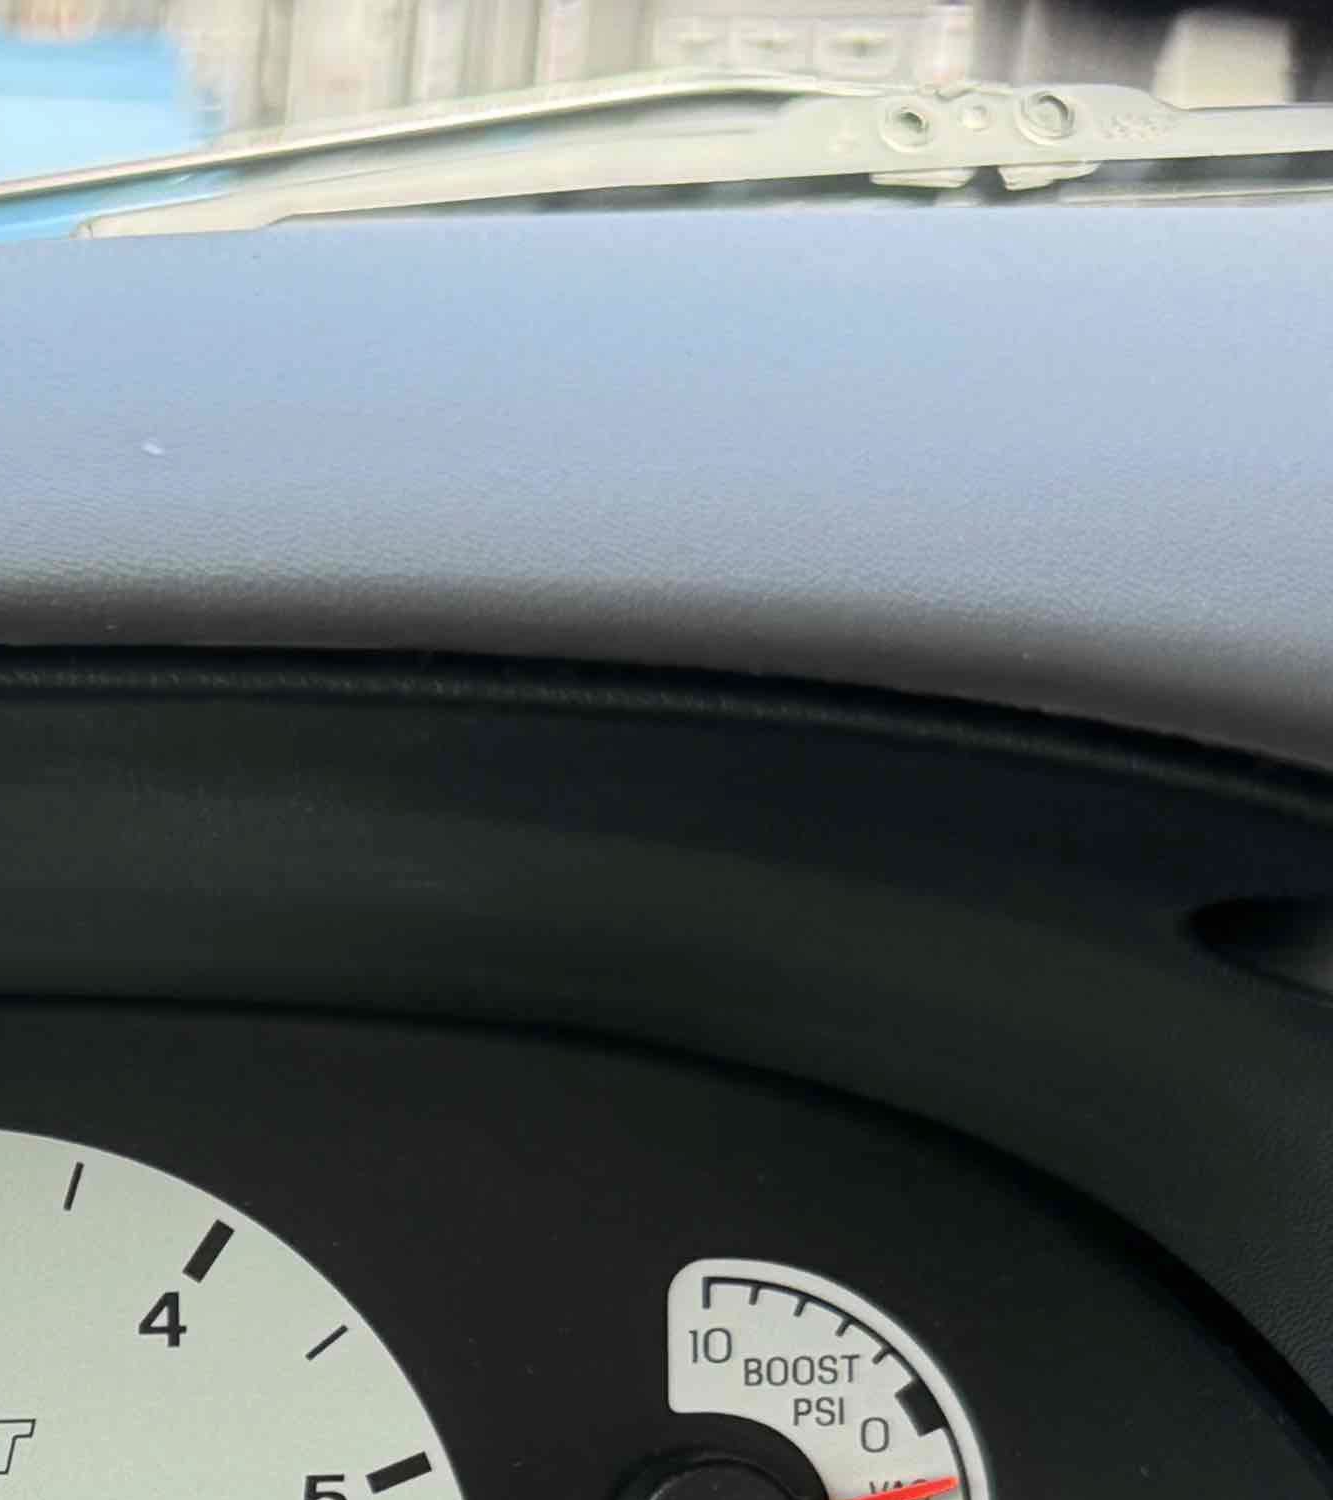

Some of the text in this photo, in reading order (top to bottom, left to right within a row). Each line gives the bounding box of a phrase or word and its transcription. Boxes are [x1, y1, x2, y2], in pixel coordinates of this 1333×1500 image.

[139, 1292, 187, 1347] 4
[689, 1328, 732, 1363] 10
[744, 1354, 860, 1386] BOOST
[794, 1397, 844, 1426] PSI
[861, 1417, 889, 1453] 0
